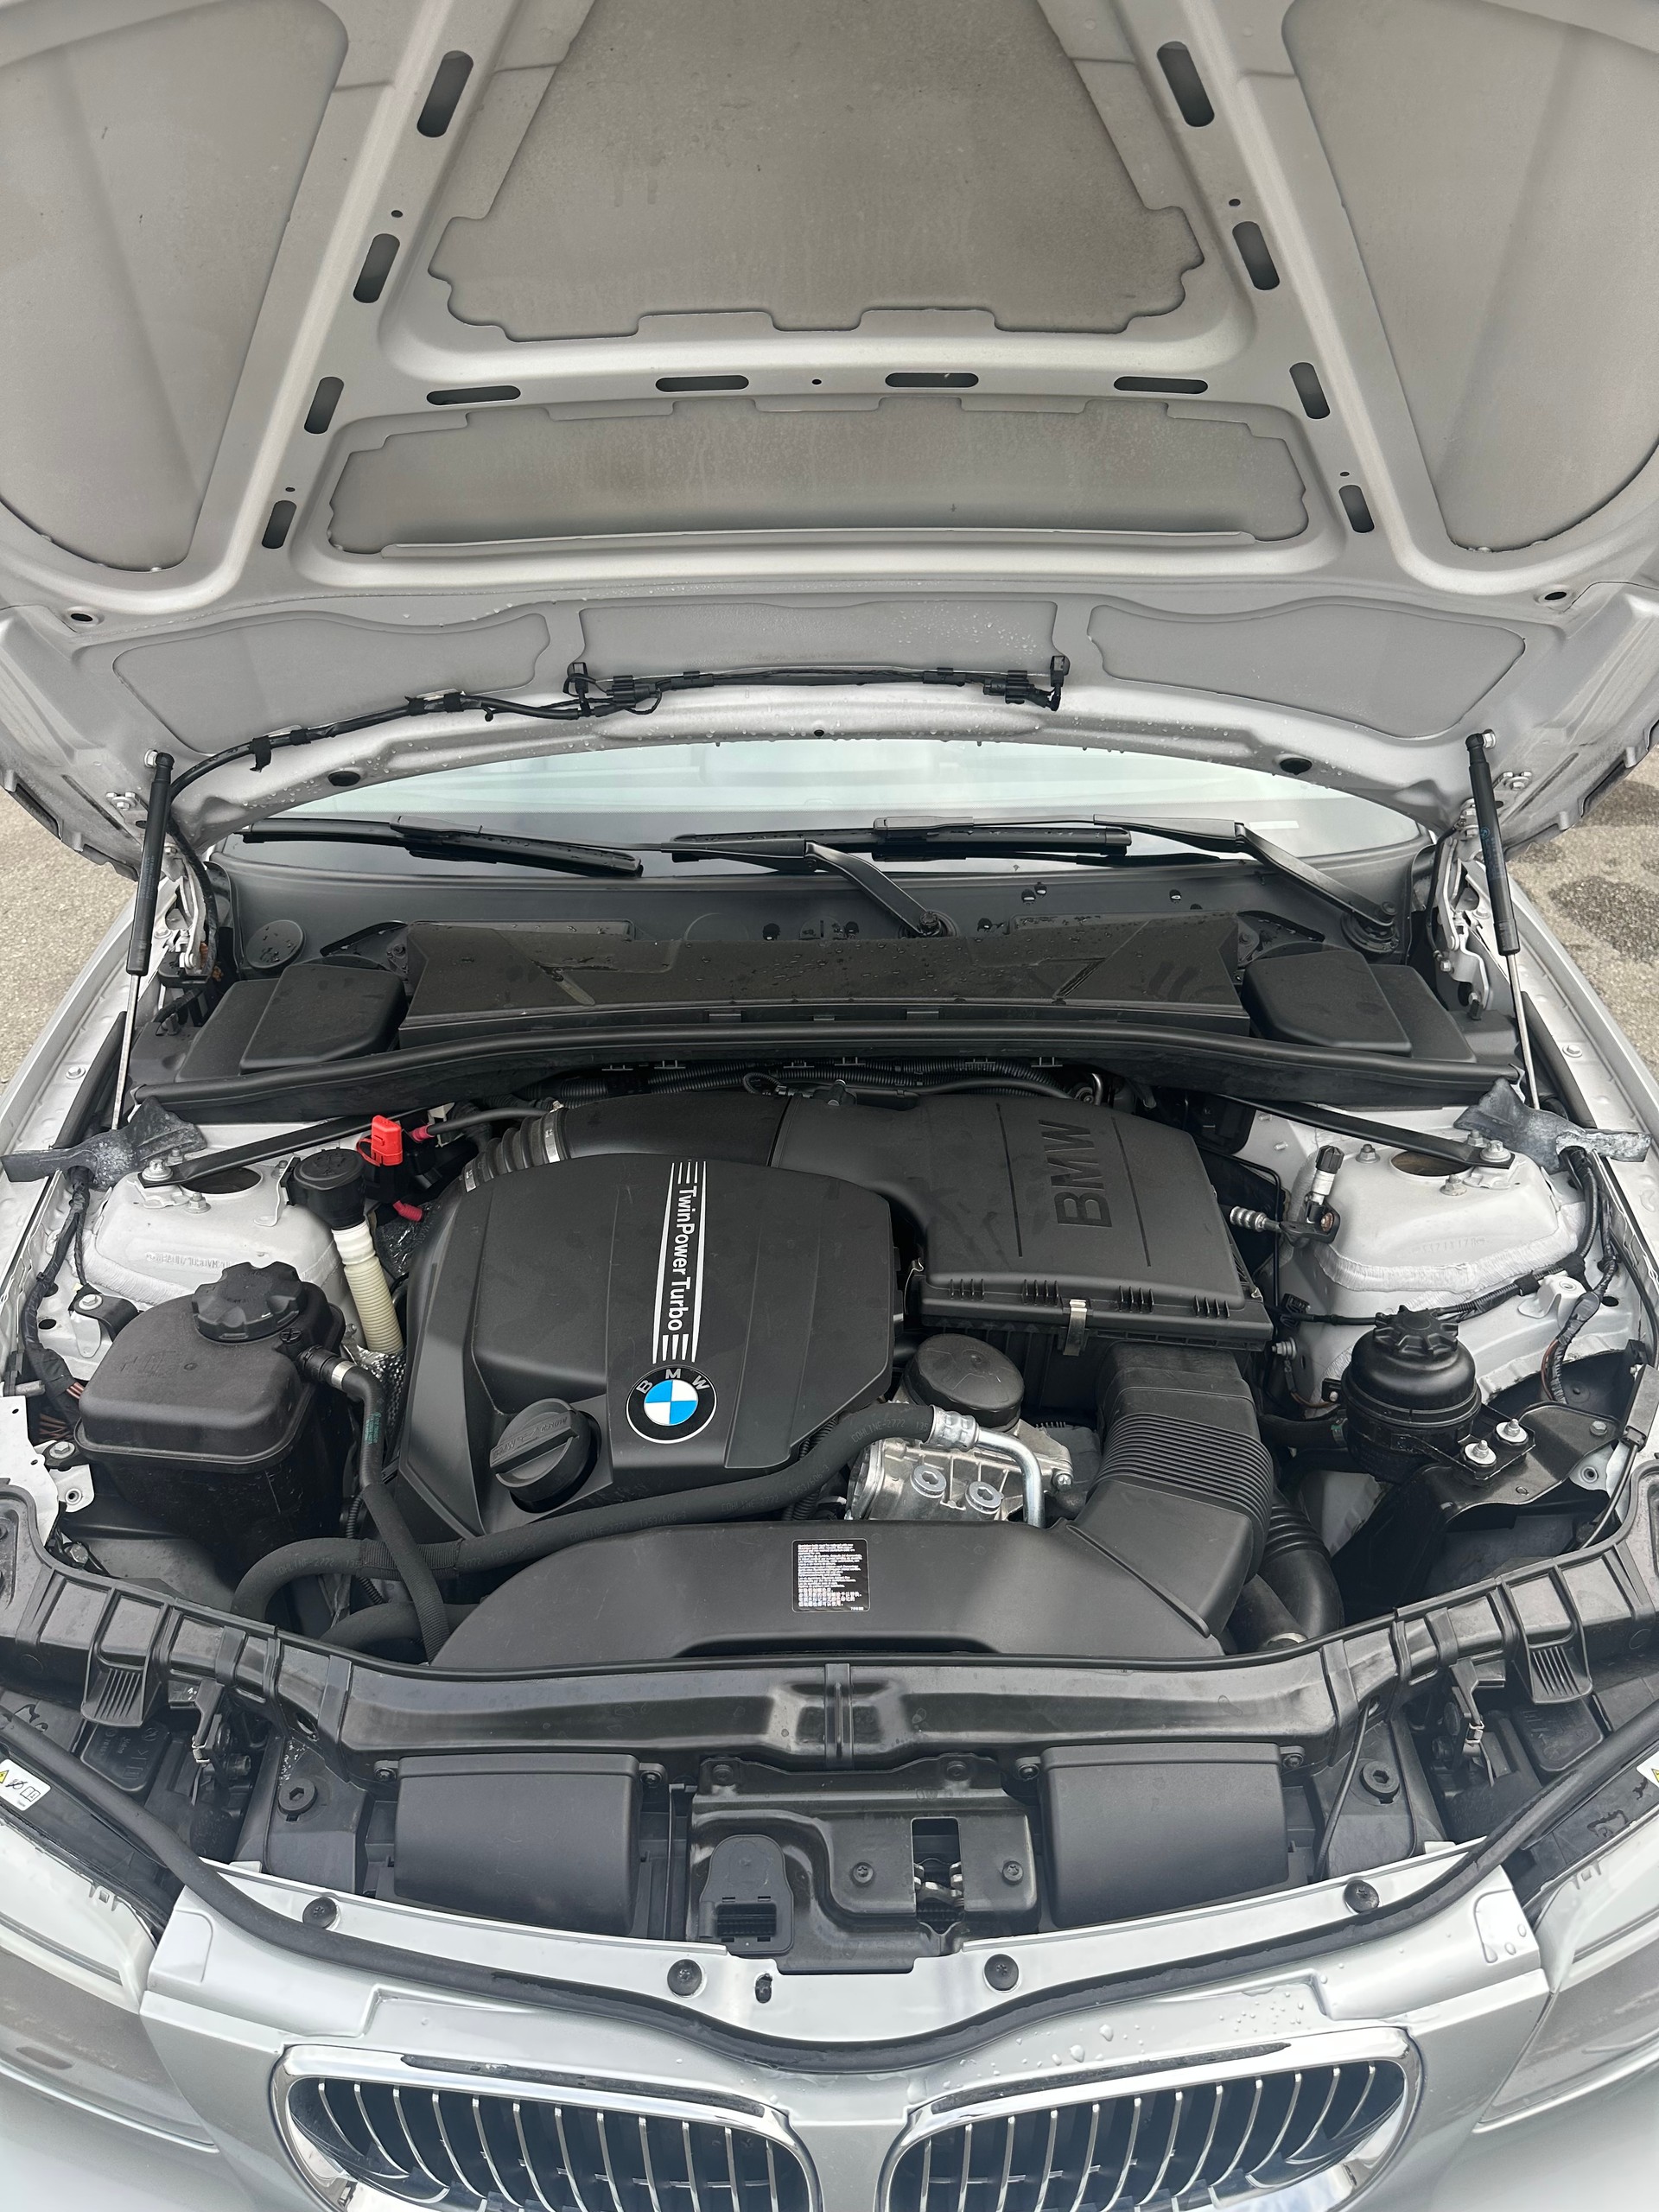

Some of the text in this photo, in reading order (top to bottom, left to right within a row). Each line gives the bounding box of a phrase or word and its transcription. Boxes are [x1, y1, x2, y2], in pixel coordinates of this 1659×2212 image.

[1038, 1119, 1112, 1228] BMW
[668, 1185, 697, 1331] TwinPower Turbo
[636, 1368, 710, 1394] BMW
[851, 1418, 906, 1443] COHLINE-2772
